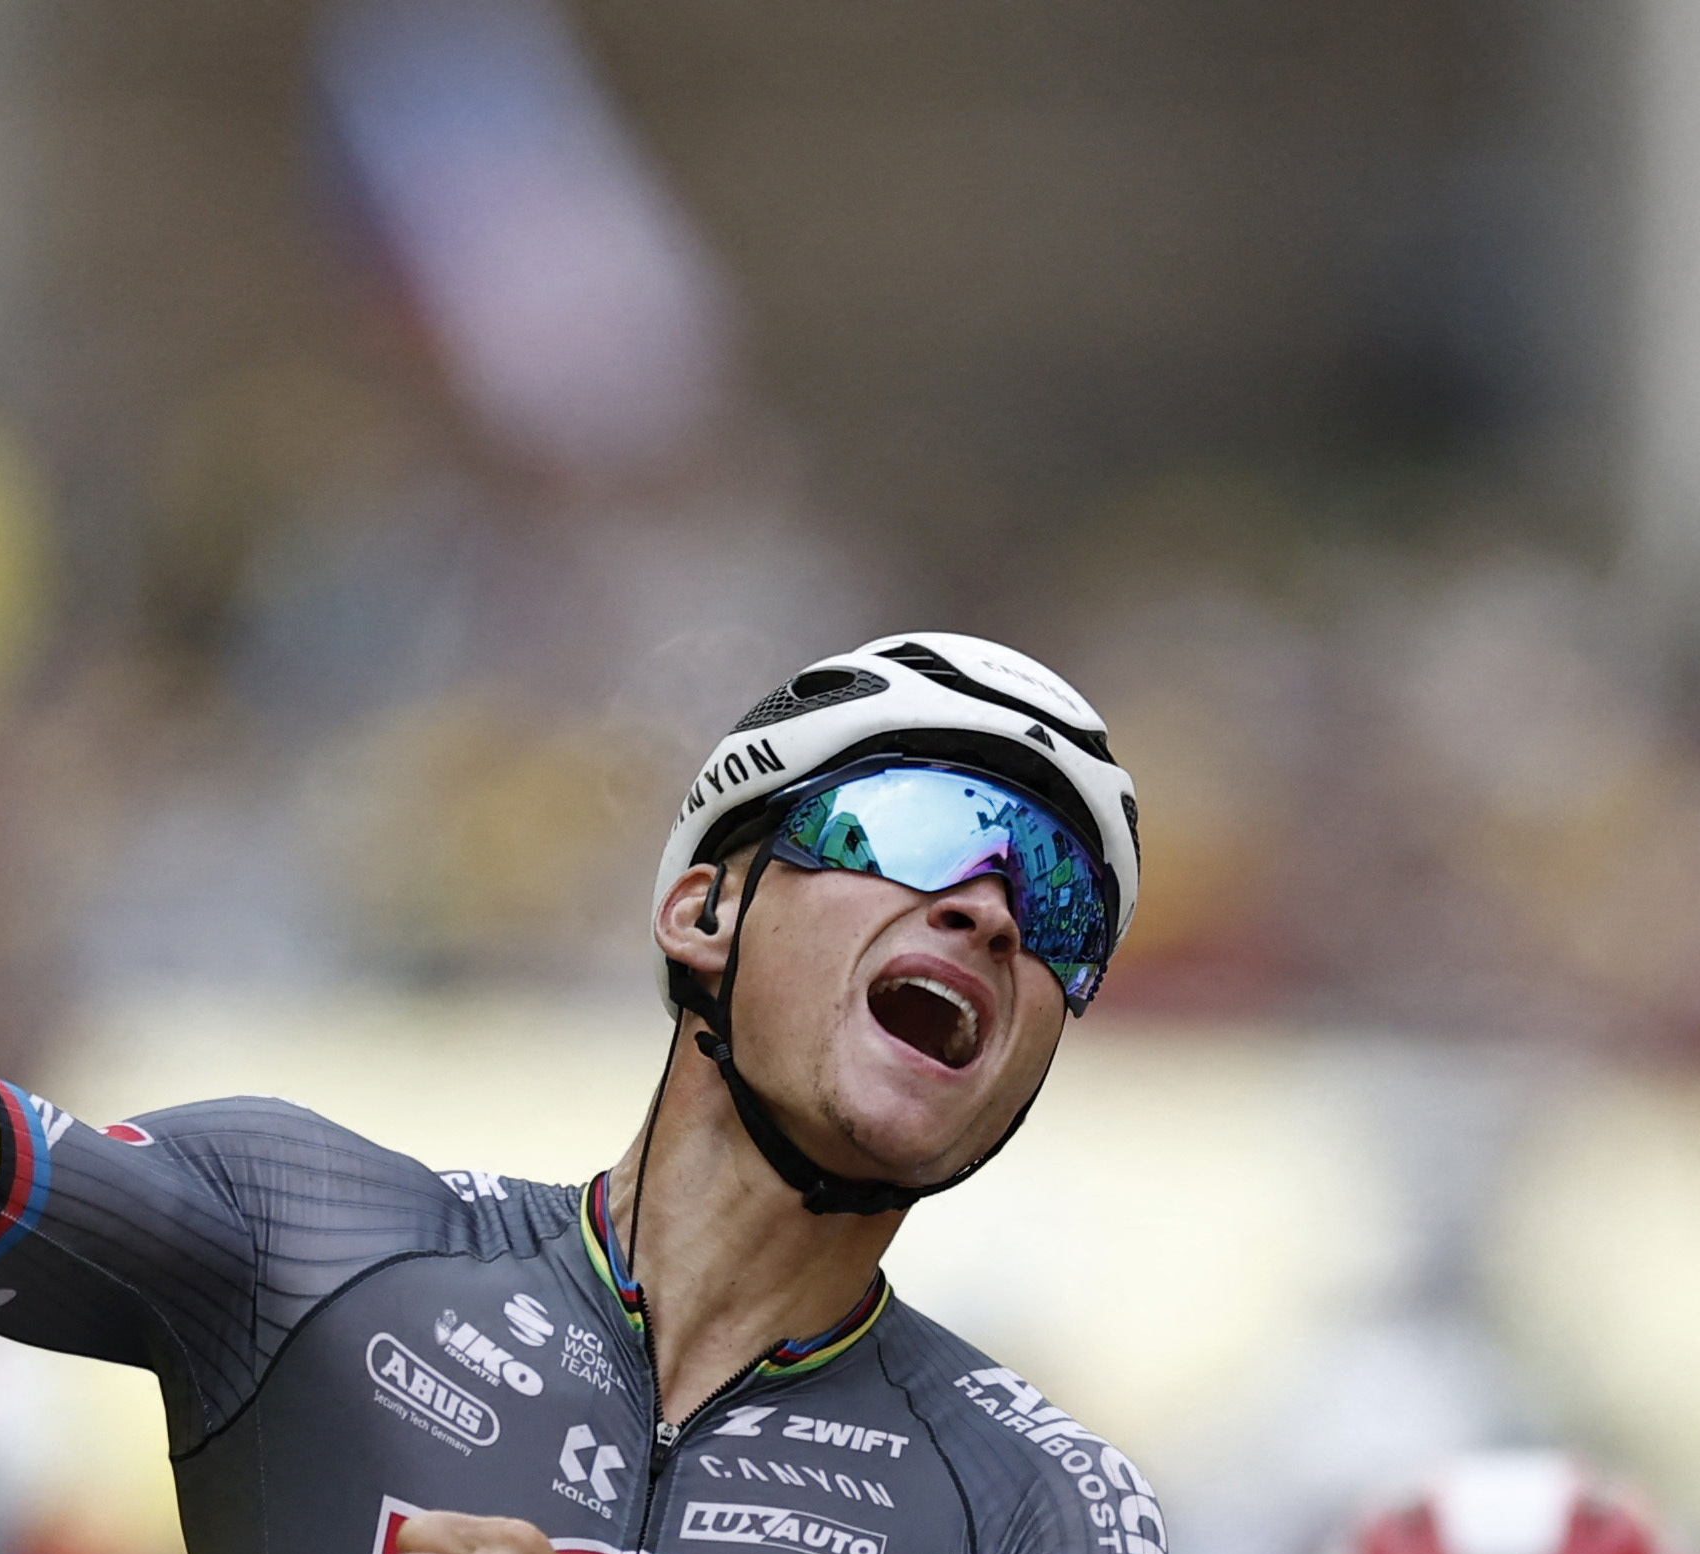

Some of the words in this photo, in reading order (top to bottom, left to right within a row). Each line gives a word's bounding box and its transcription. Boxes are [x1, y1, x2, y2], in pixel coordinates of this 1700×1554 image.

[673, 738, 786, 832] NYON
[444, 1344, 502, 1387] ISOLATIE
[448, 1322, 545, 1396] IKO
[566, 1323, 603, 1354] UCI
[380, 1350, 483, 1434] ABUS
[560, 1351, 612, 1395] TEAM
[372, 1389, 409, 1420] Security
[407, 1411, 431, 1433] Tech
[430, 1425, 473, 1458] Germany
[953, 1375, 1035, 1434] HAIR
[782, 1415, 910, 1459] ZWIFT
[700, 1454, 896, 1509] CANYON
